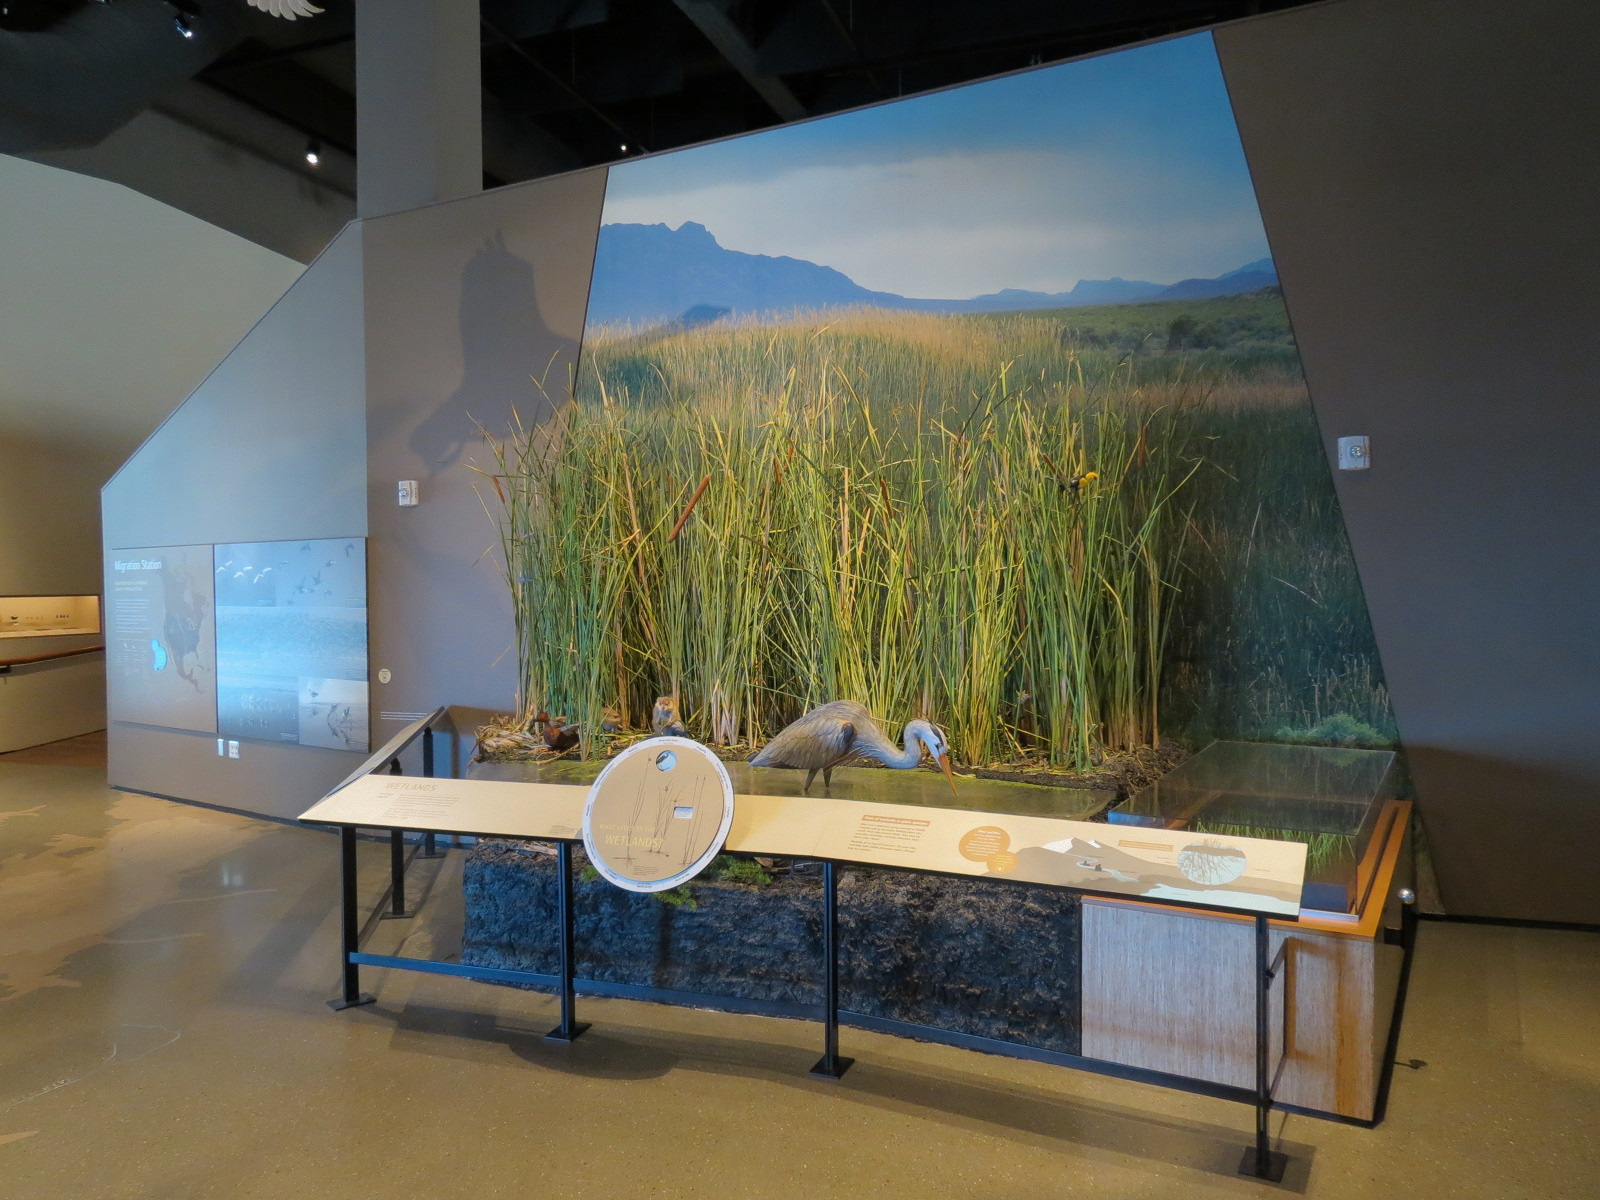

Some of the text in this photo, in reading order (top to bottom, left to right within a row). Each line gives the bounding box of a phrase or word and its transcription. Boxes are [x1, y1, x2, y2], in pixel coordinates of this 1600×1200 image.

[114, 559, 162, 573] Migration Station
[385, 782, 438, 792] WETLANDS
[605, 835, 664, 848] WETLANDS?
